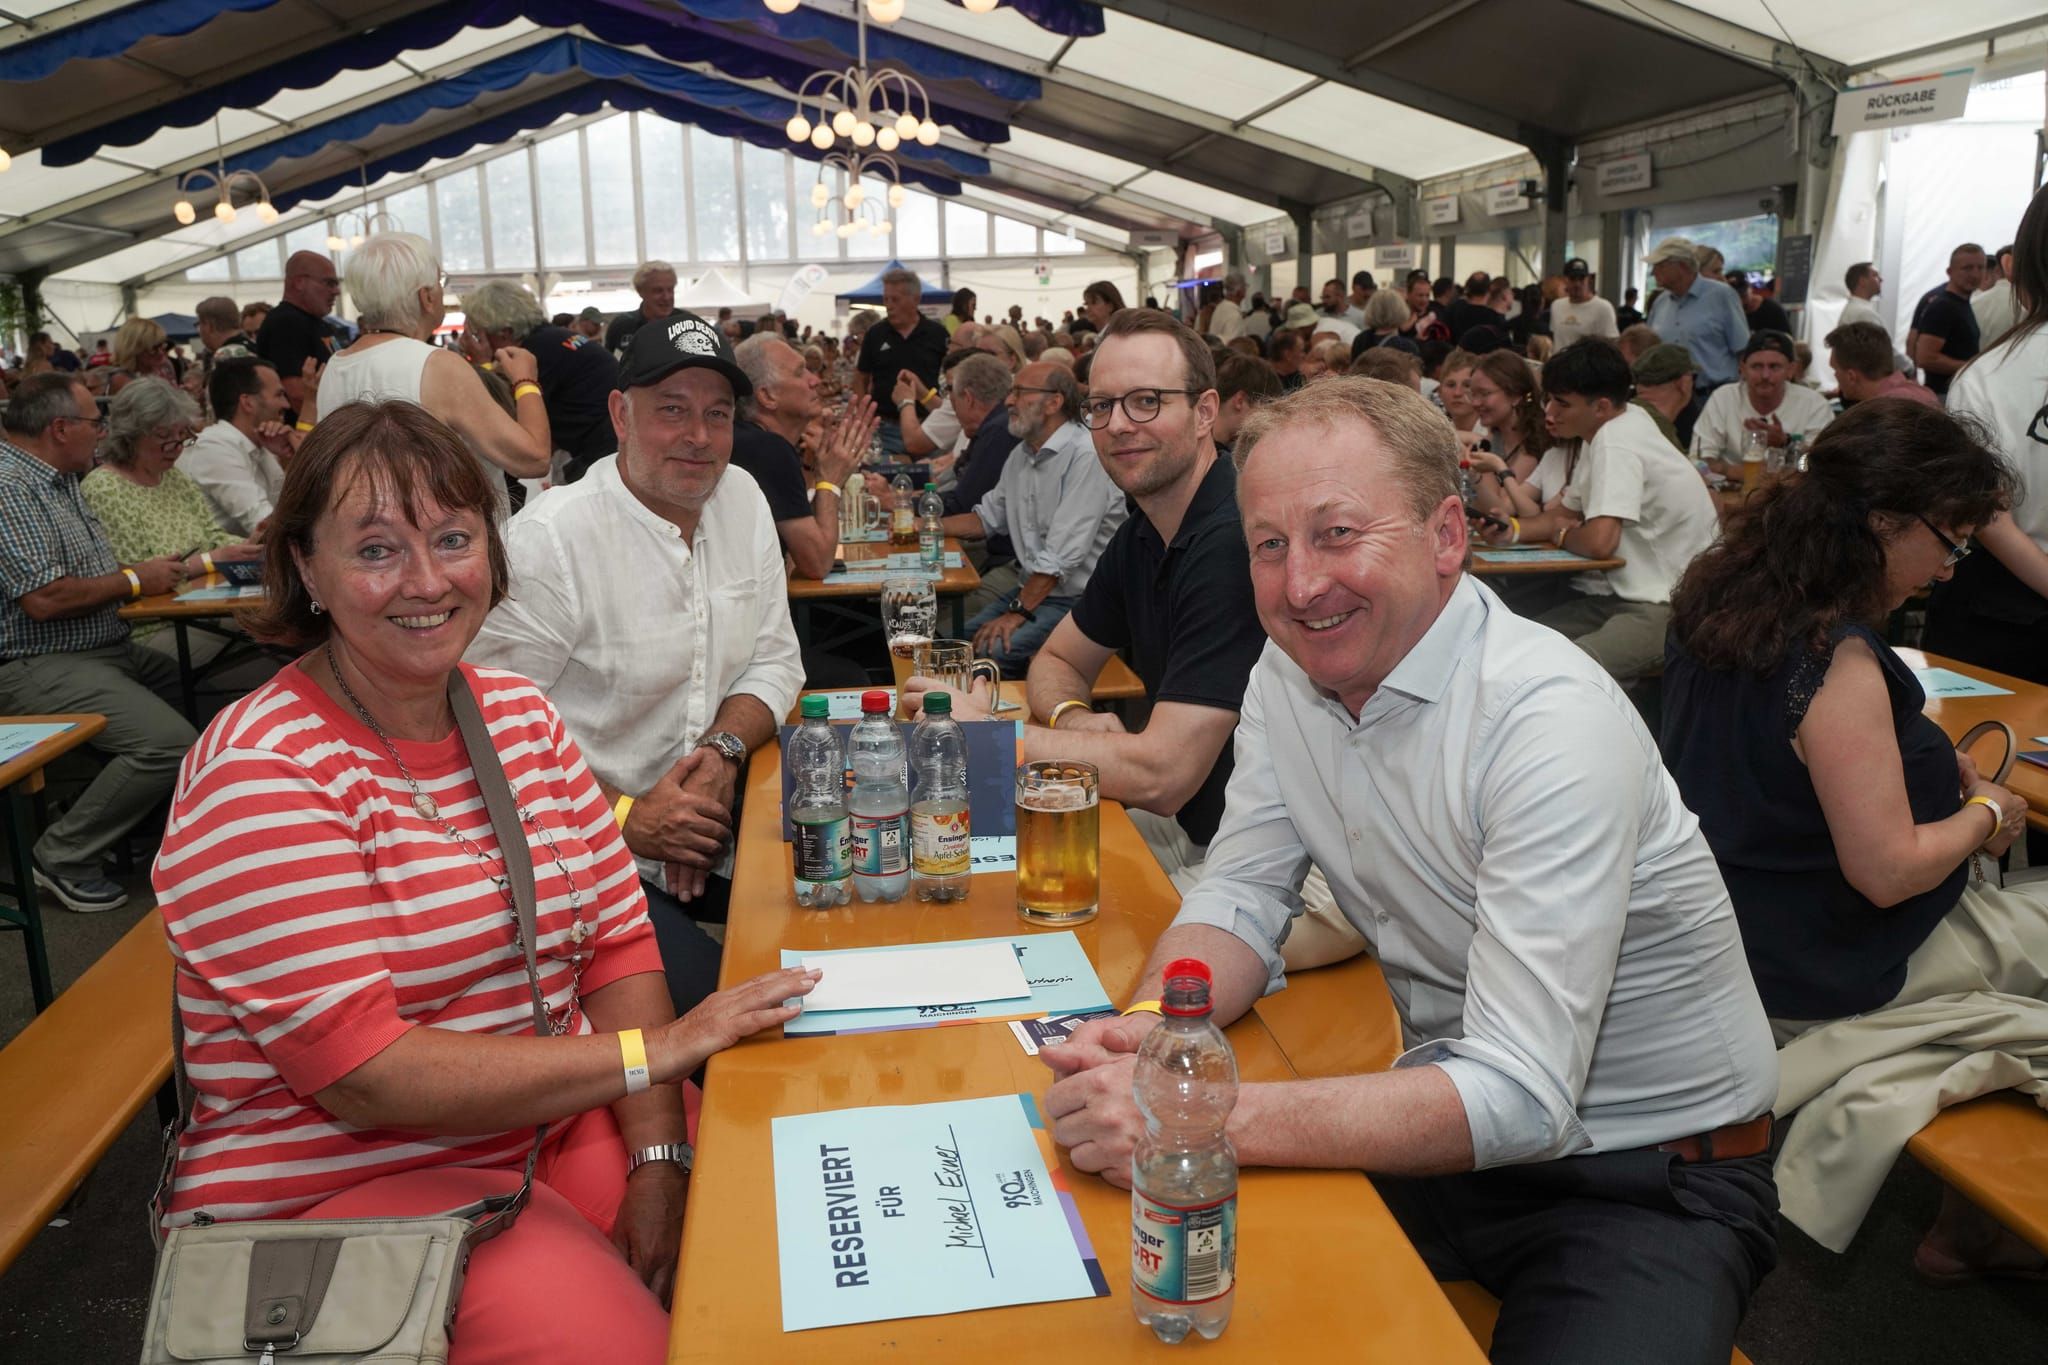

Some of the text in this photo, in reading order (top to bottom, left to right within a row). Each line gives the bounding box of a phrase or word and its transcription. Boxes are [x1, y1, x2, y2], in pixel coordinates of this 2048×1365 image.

[1867, 89, 1937, 109] RÜCKGABE
[1898, 105, 1934, 116] Flaschen
[668, 319, 720, 348] LIQUID DEATH
[920, 1010, 977, 1018] MAICHINGEN
[875, 1185, 905, 1218] FÜR
[1000, 1181, 1031, 1208] 950
[1023, 1169, 1043, 1206] MAICHINGEN
[820, 1144, 869, 1288] RESERVIERT
[937, 1197, 985, 1249] Michael
